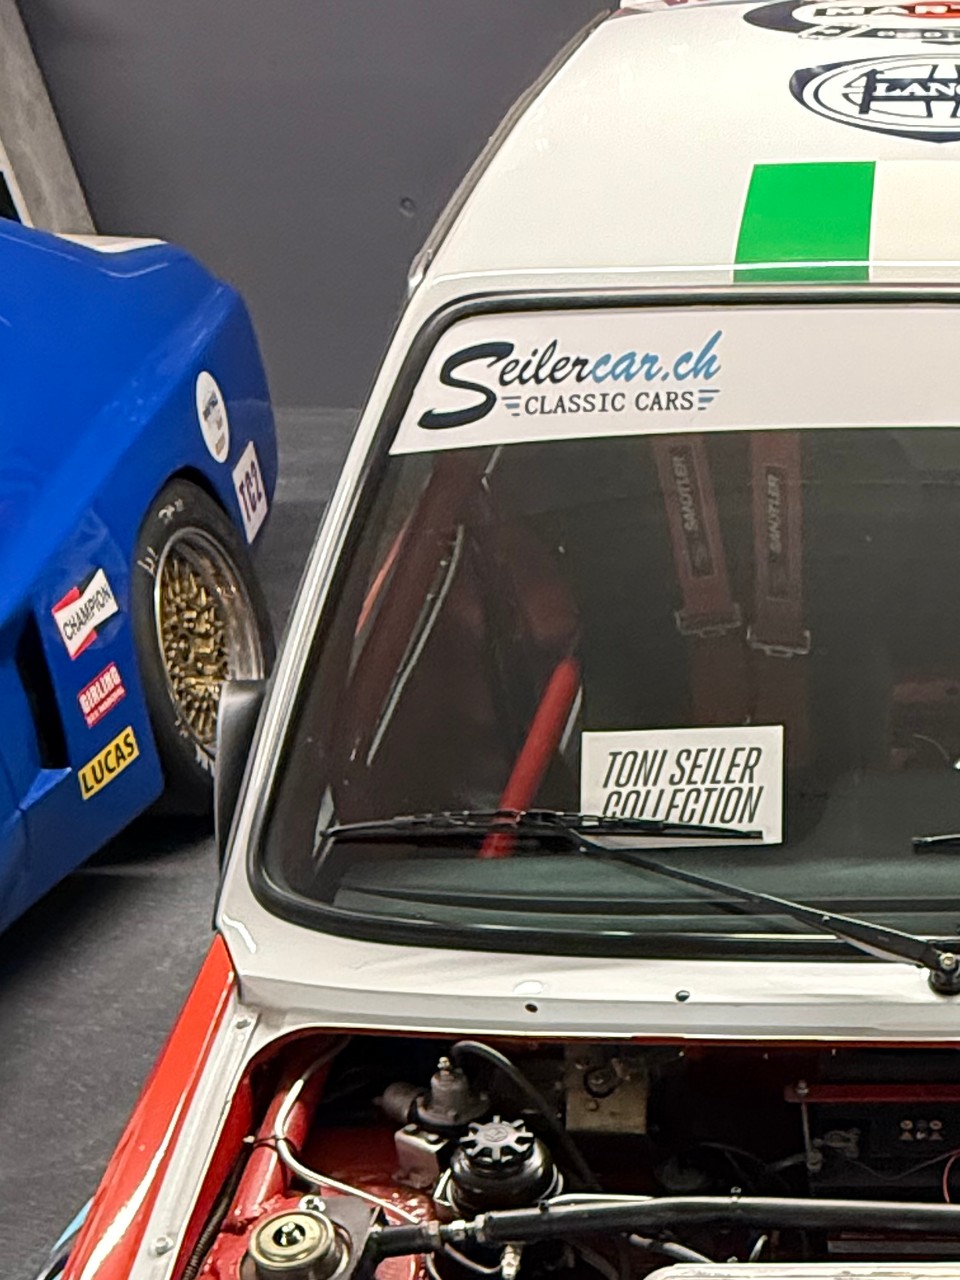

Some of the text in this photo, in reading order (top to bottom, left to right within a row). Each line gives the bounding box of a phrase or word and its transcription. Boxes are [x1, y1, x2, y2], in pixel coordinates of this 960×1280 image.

[417, 330, 723, 430] Seilercar.ch
[524, 391, 694, 415] CLASSIC CARS
[62, 585, 113, 641] CHAMPION
[81, 733, 135, 794] LUCAS
[602, 746, 762, 789] TONI SEILER
